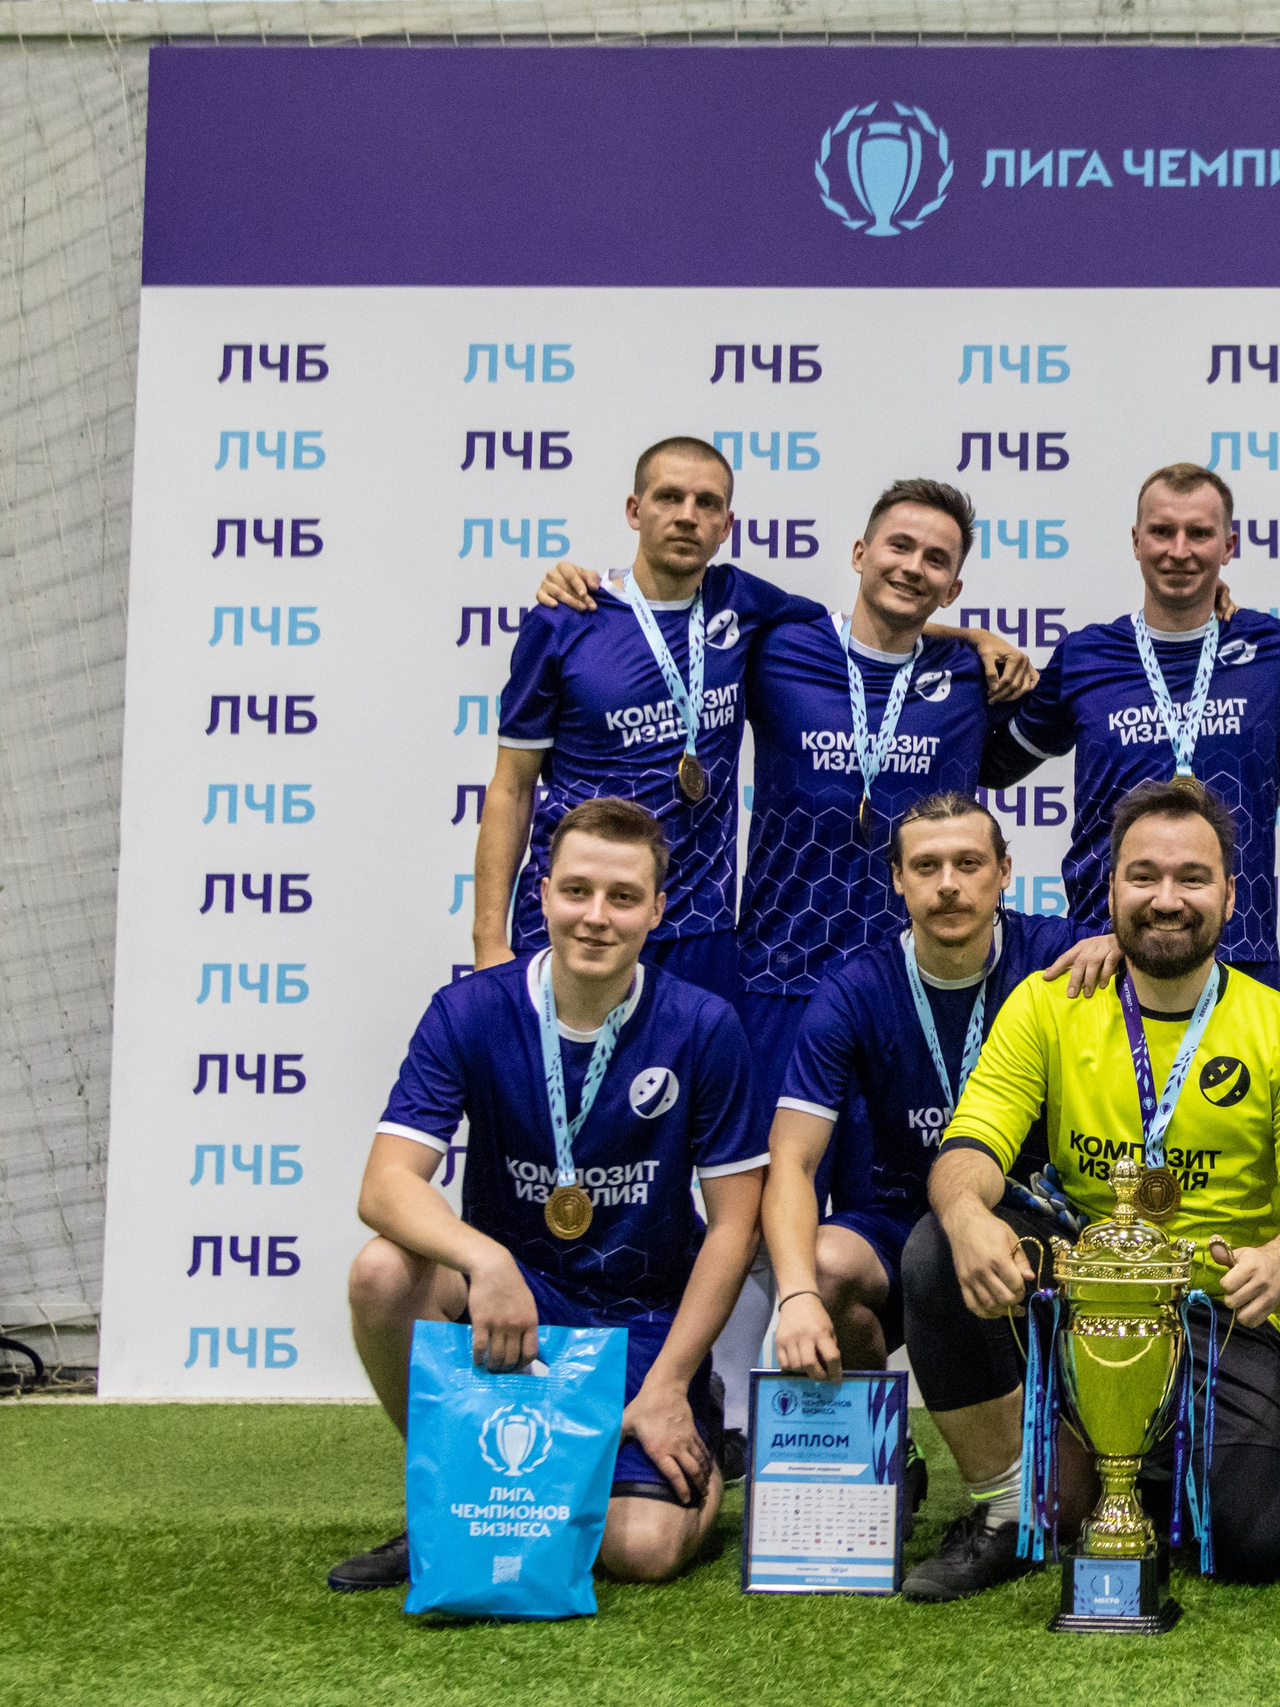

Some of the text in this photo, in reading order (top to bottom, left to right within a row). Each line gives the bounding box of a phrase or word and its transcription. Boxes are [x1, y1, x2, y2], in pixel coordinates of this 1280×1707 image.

[981, 149, 1113, 189] ЛИГА
[218, 344, 329, 384] ЛЧБ
[464, 344, 574, 383] ЛЧБ
[710, 344, 822, 384] ЛЧБ
[958, 345, 1070, 384] ЛЧБ
[215, 431, 325, 470] ЛЧБ
[461, 431, 572, 471] ЛЧБ
[713, 431, 820, 471] ЛЧБ
[956, 432, 1069, 472] ЛЧБ
[212, 518, 323, 559] ЛЧБ
[459, 519, 570, 558] ЛЧБ
[209, 607, 320, 646] ЛЧБ
[456, 607, 528, 647] ЛЧ
[205, 695, 317, 736] ЛЧБ
[813, 751, 931, 775] ИЗДЛИЯ
[203, 784, 315, 824] ЛЧБ
[199, 873, 312, 914] ЛЧБ
[1004, 876, 1066, 917] ЧБ
[197, 964, 309, 1004] ЛЧБ
[1123, 982, 1132, 1008] ФУТБОЛ
[1199, 997, 1210, 1018] ВЕСНА
[193, 1054, 306, 1095] ЛЧБ
[190, 1145, 303, 1185] ЛЧБ
[1070, 1129, 1222, 1170] КОМПЗИТ
[515, 1179, 648, 1206] ИЗЛИЯ
[1079, 1154, 1209, 1191] ИЗИЯ
[187, 1236, 301, 1277] ЛЧБ
[184, 1327, 298, 1368] ЛЧБ
[771, 1433, 849, 1449] ДИПЛОМ
[451, 1503, 570, 1520] ЧЕМПИОНОВ
[489, 1486, 536, 1502] ЛИГА
[469, 1521, 551, 1537] БИЗНЕСА
[1103, 1574, 1110, 1596] 1
